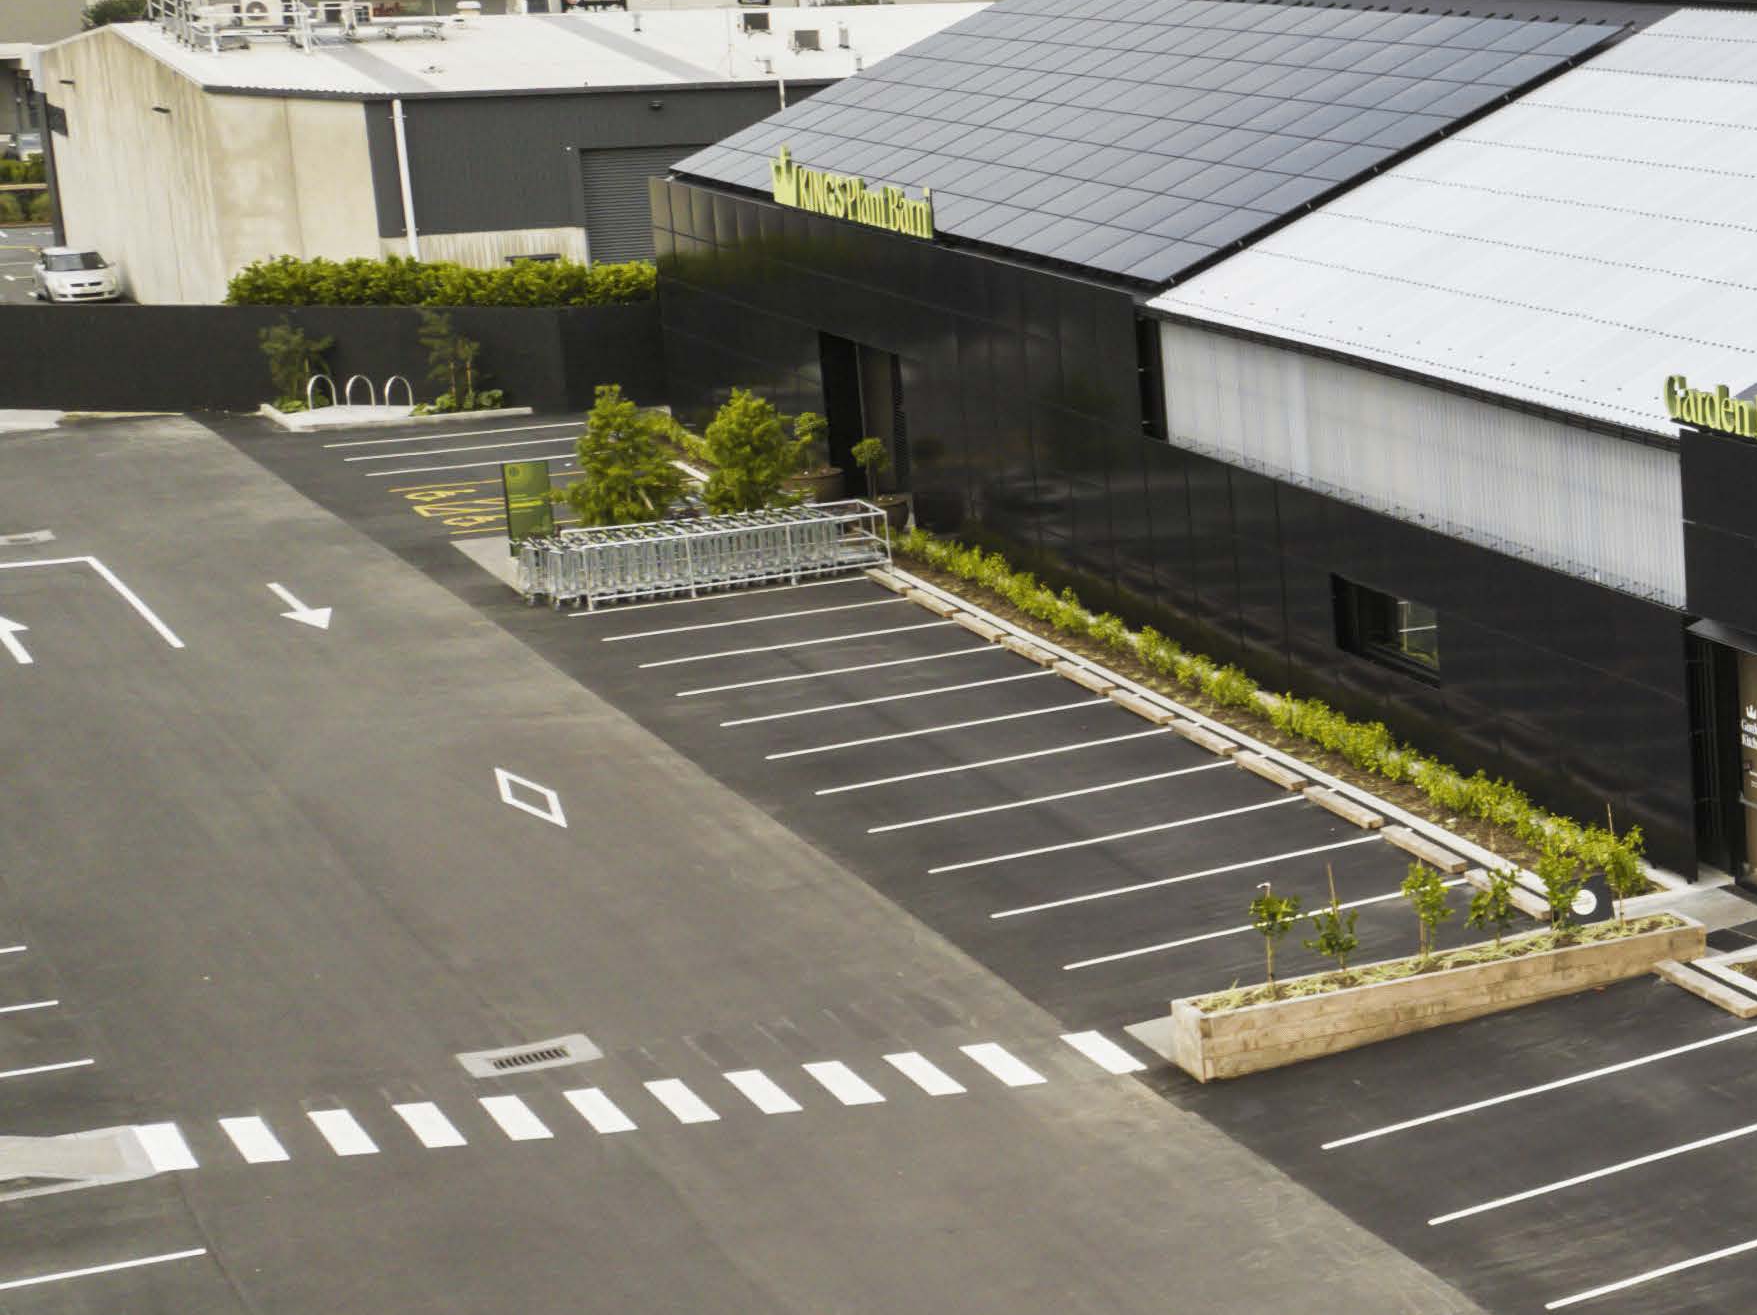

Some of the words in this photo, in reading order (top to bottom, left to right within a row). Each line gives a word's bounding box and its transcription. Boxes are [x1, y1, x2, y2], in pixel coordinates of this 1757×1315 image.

[800, 167, 847, 218] KINGS
[847, 177, 887, 227] Plant
[887, 187, 934, 239] Barn
[1664, 375, 1750, 436] Garden
